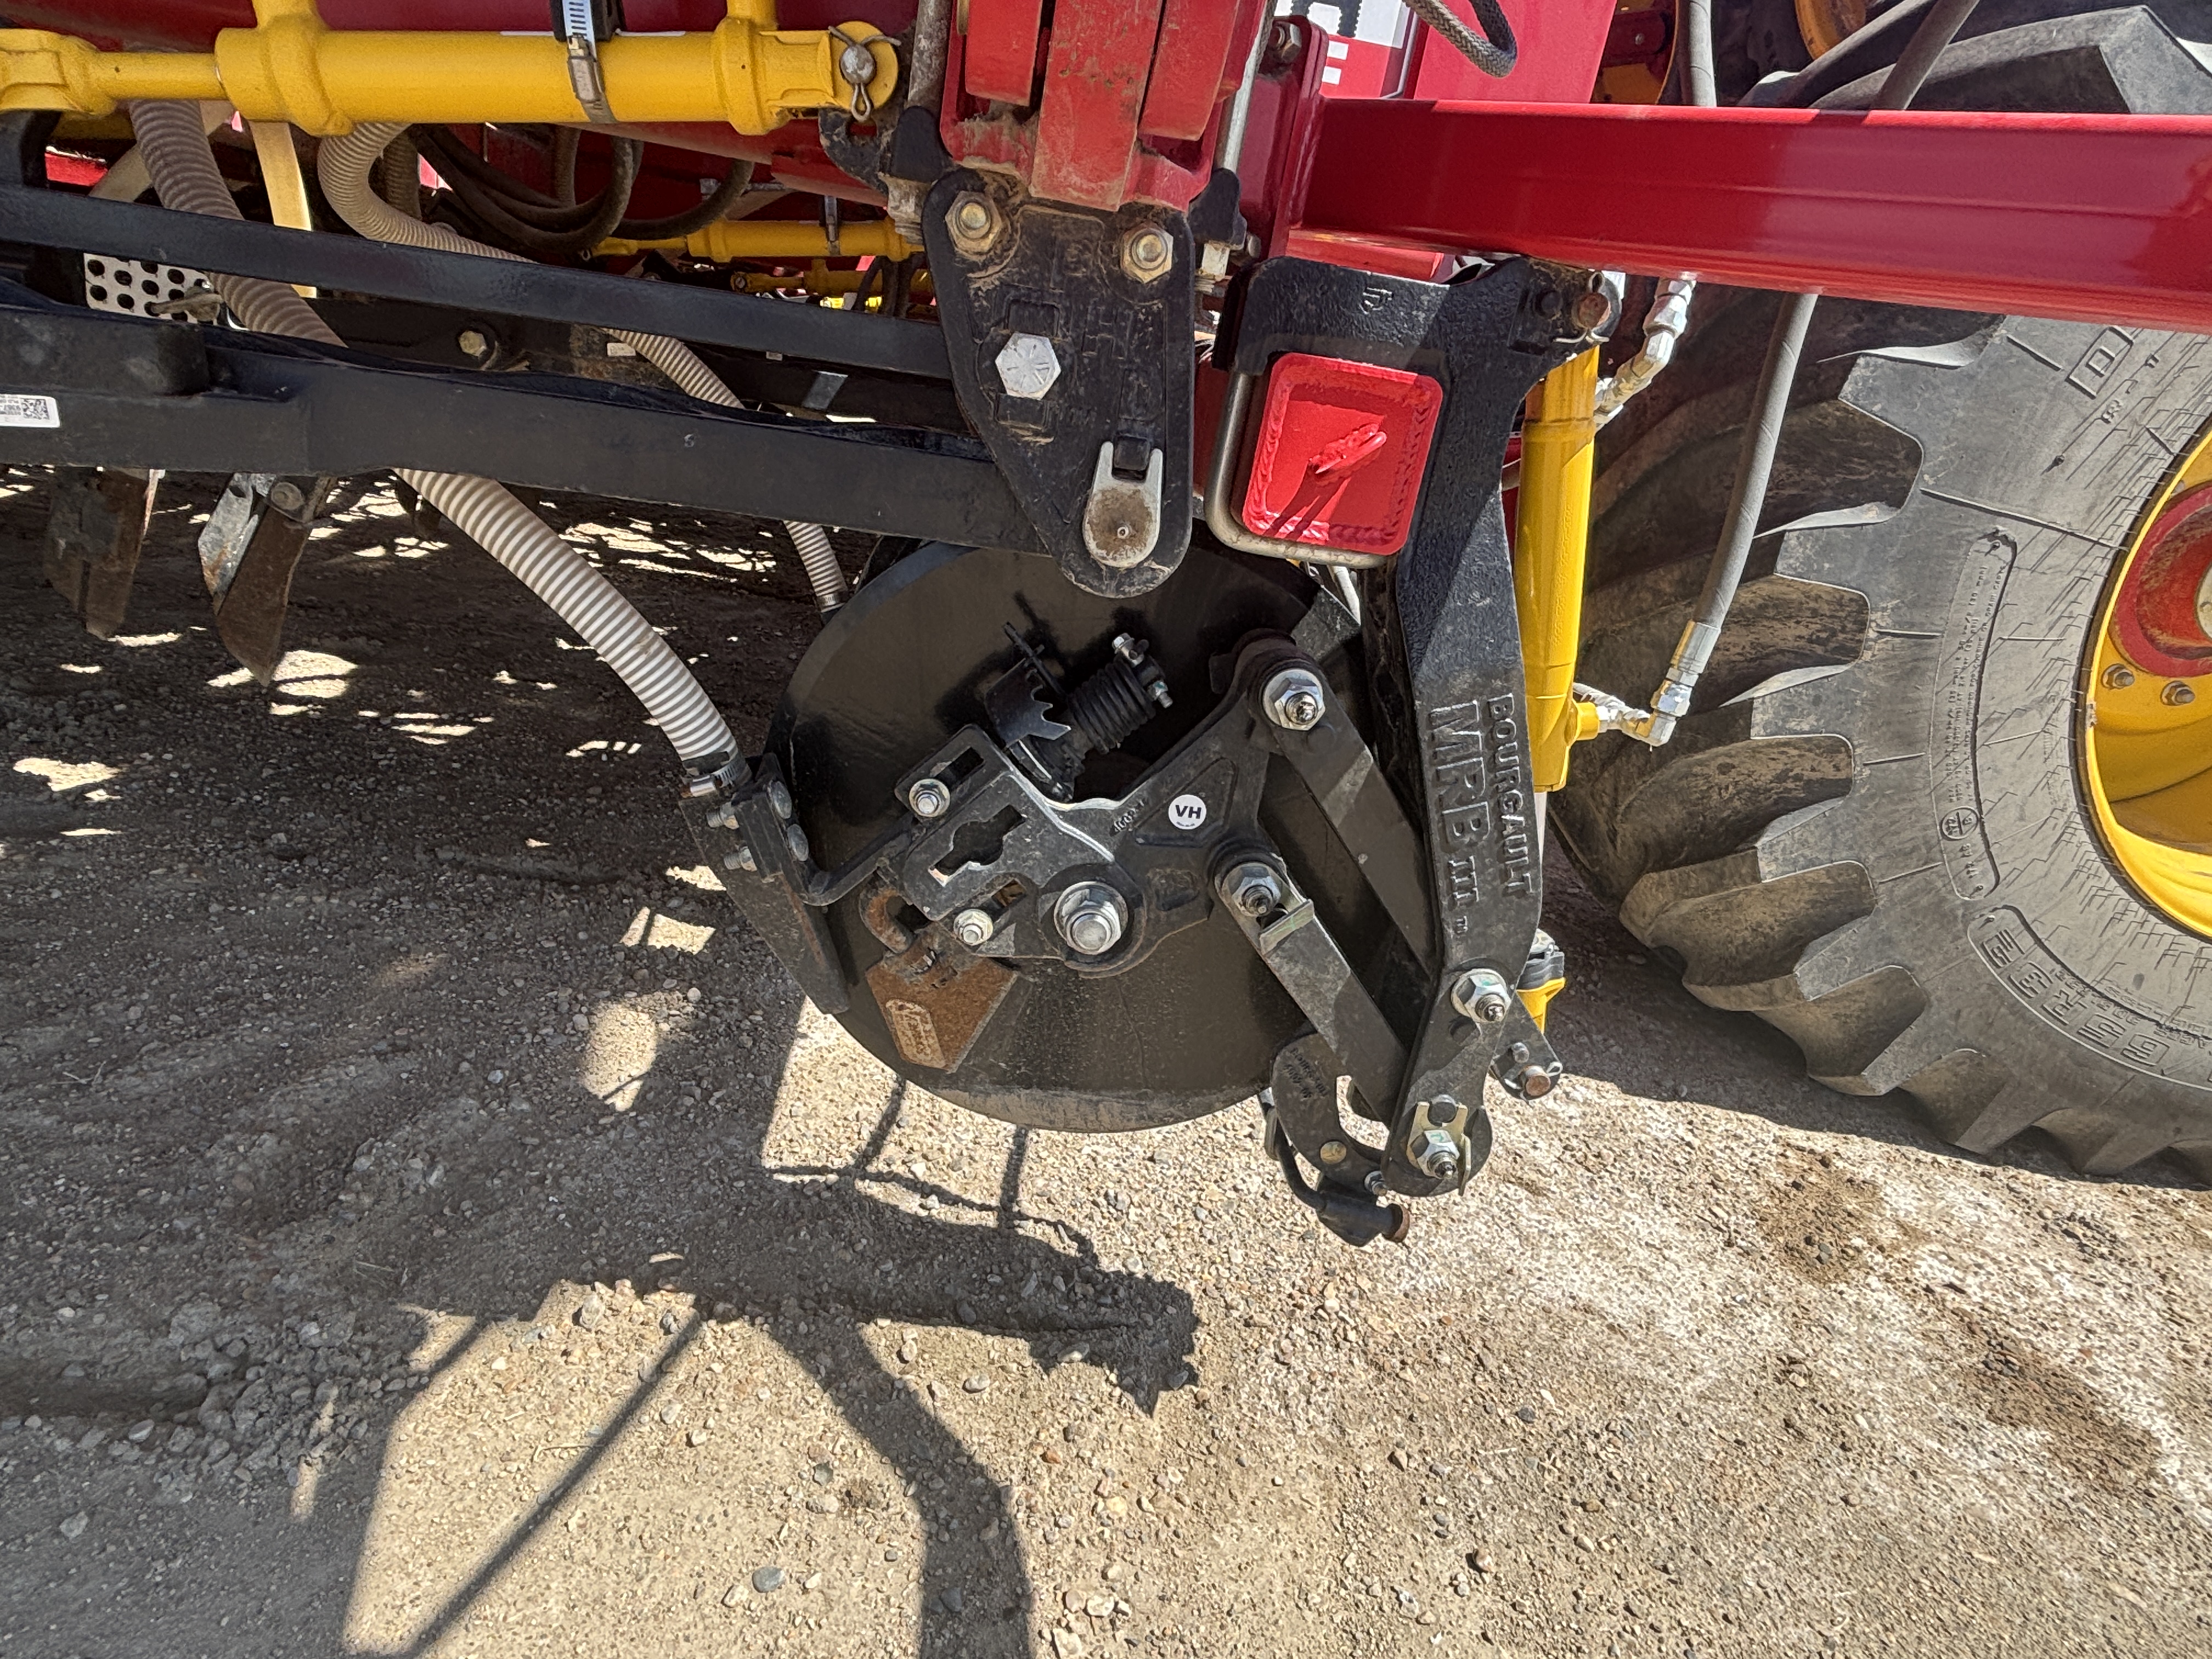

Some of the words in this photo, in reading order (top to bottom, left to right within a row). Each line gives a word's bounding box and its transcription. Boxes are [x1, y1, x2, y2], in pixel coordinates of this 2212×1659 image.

[1175, 804, 1203, 819] VH
[1430, 699, 1491, 845] MRB
[1487, 693, 1534, 893] BOURGAULT
